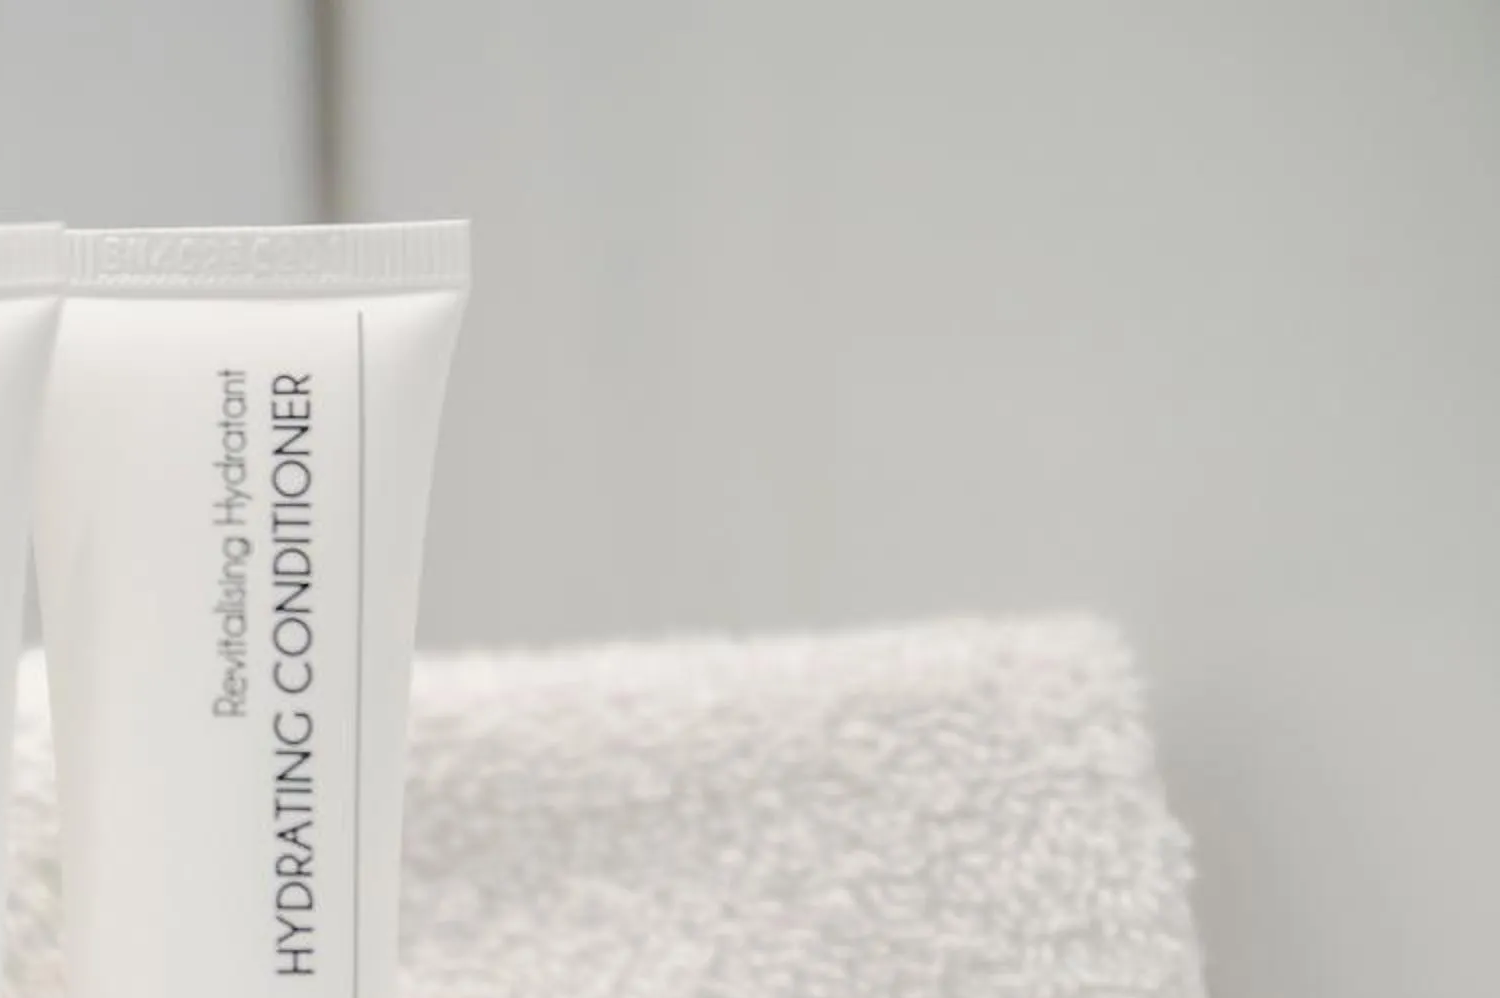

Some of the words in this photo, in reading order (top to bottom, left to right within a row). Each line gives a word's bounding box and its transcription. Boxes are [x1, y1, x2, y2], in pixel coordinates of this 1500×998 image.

[213, 370, 252, 525] Hydratant
[272, 375, 313, 694] CONDITIONER
[212, 536, 253, 717] Revitalising
[273, 712, 314, 975] HYDRATING
